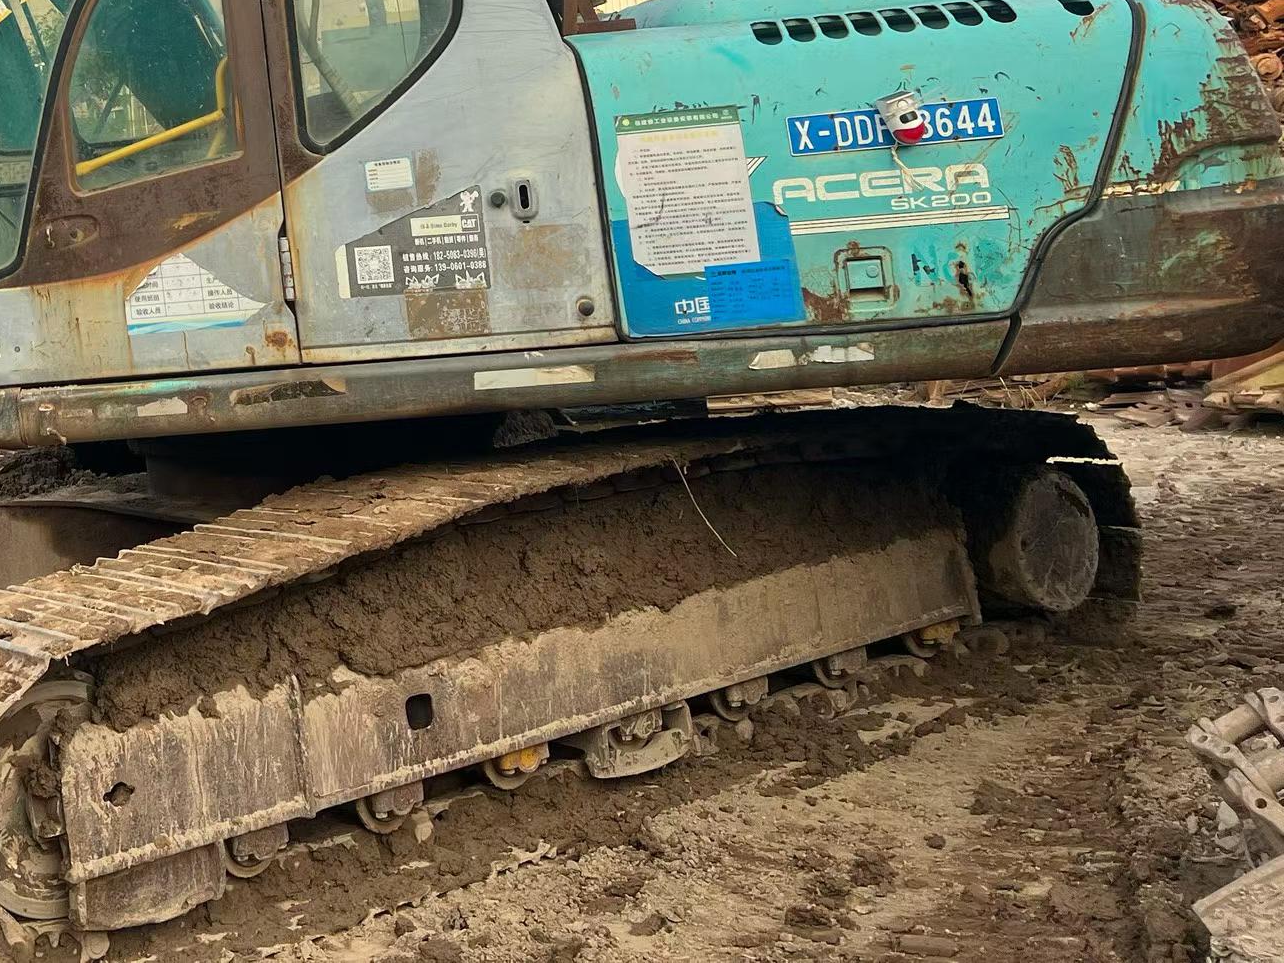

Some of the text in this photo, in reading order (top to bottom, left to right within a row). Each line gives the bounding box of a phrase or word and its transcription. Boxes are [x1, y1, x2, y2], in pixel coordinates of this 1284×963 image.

[772, 163, 989, 205] ACERA
[890, 191, 992, 210] SK200
[461, 218, 477, 229] CAT
